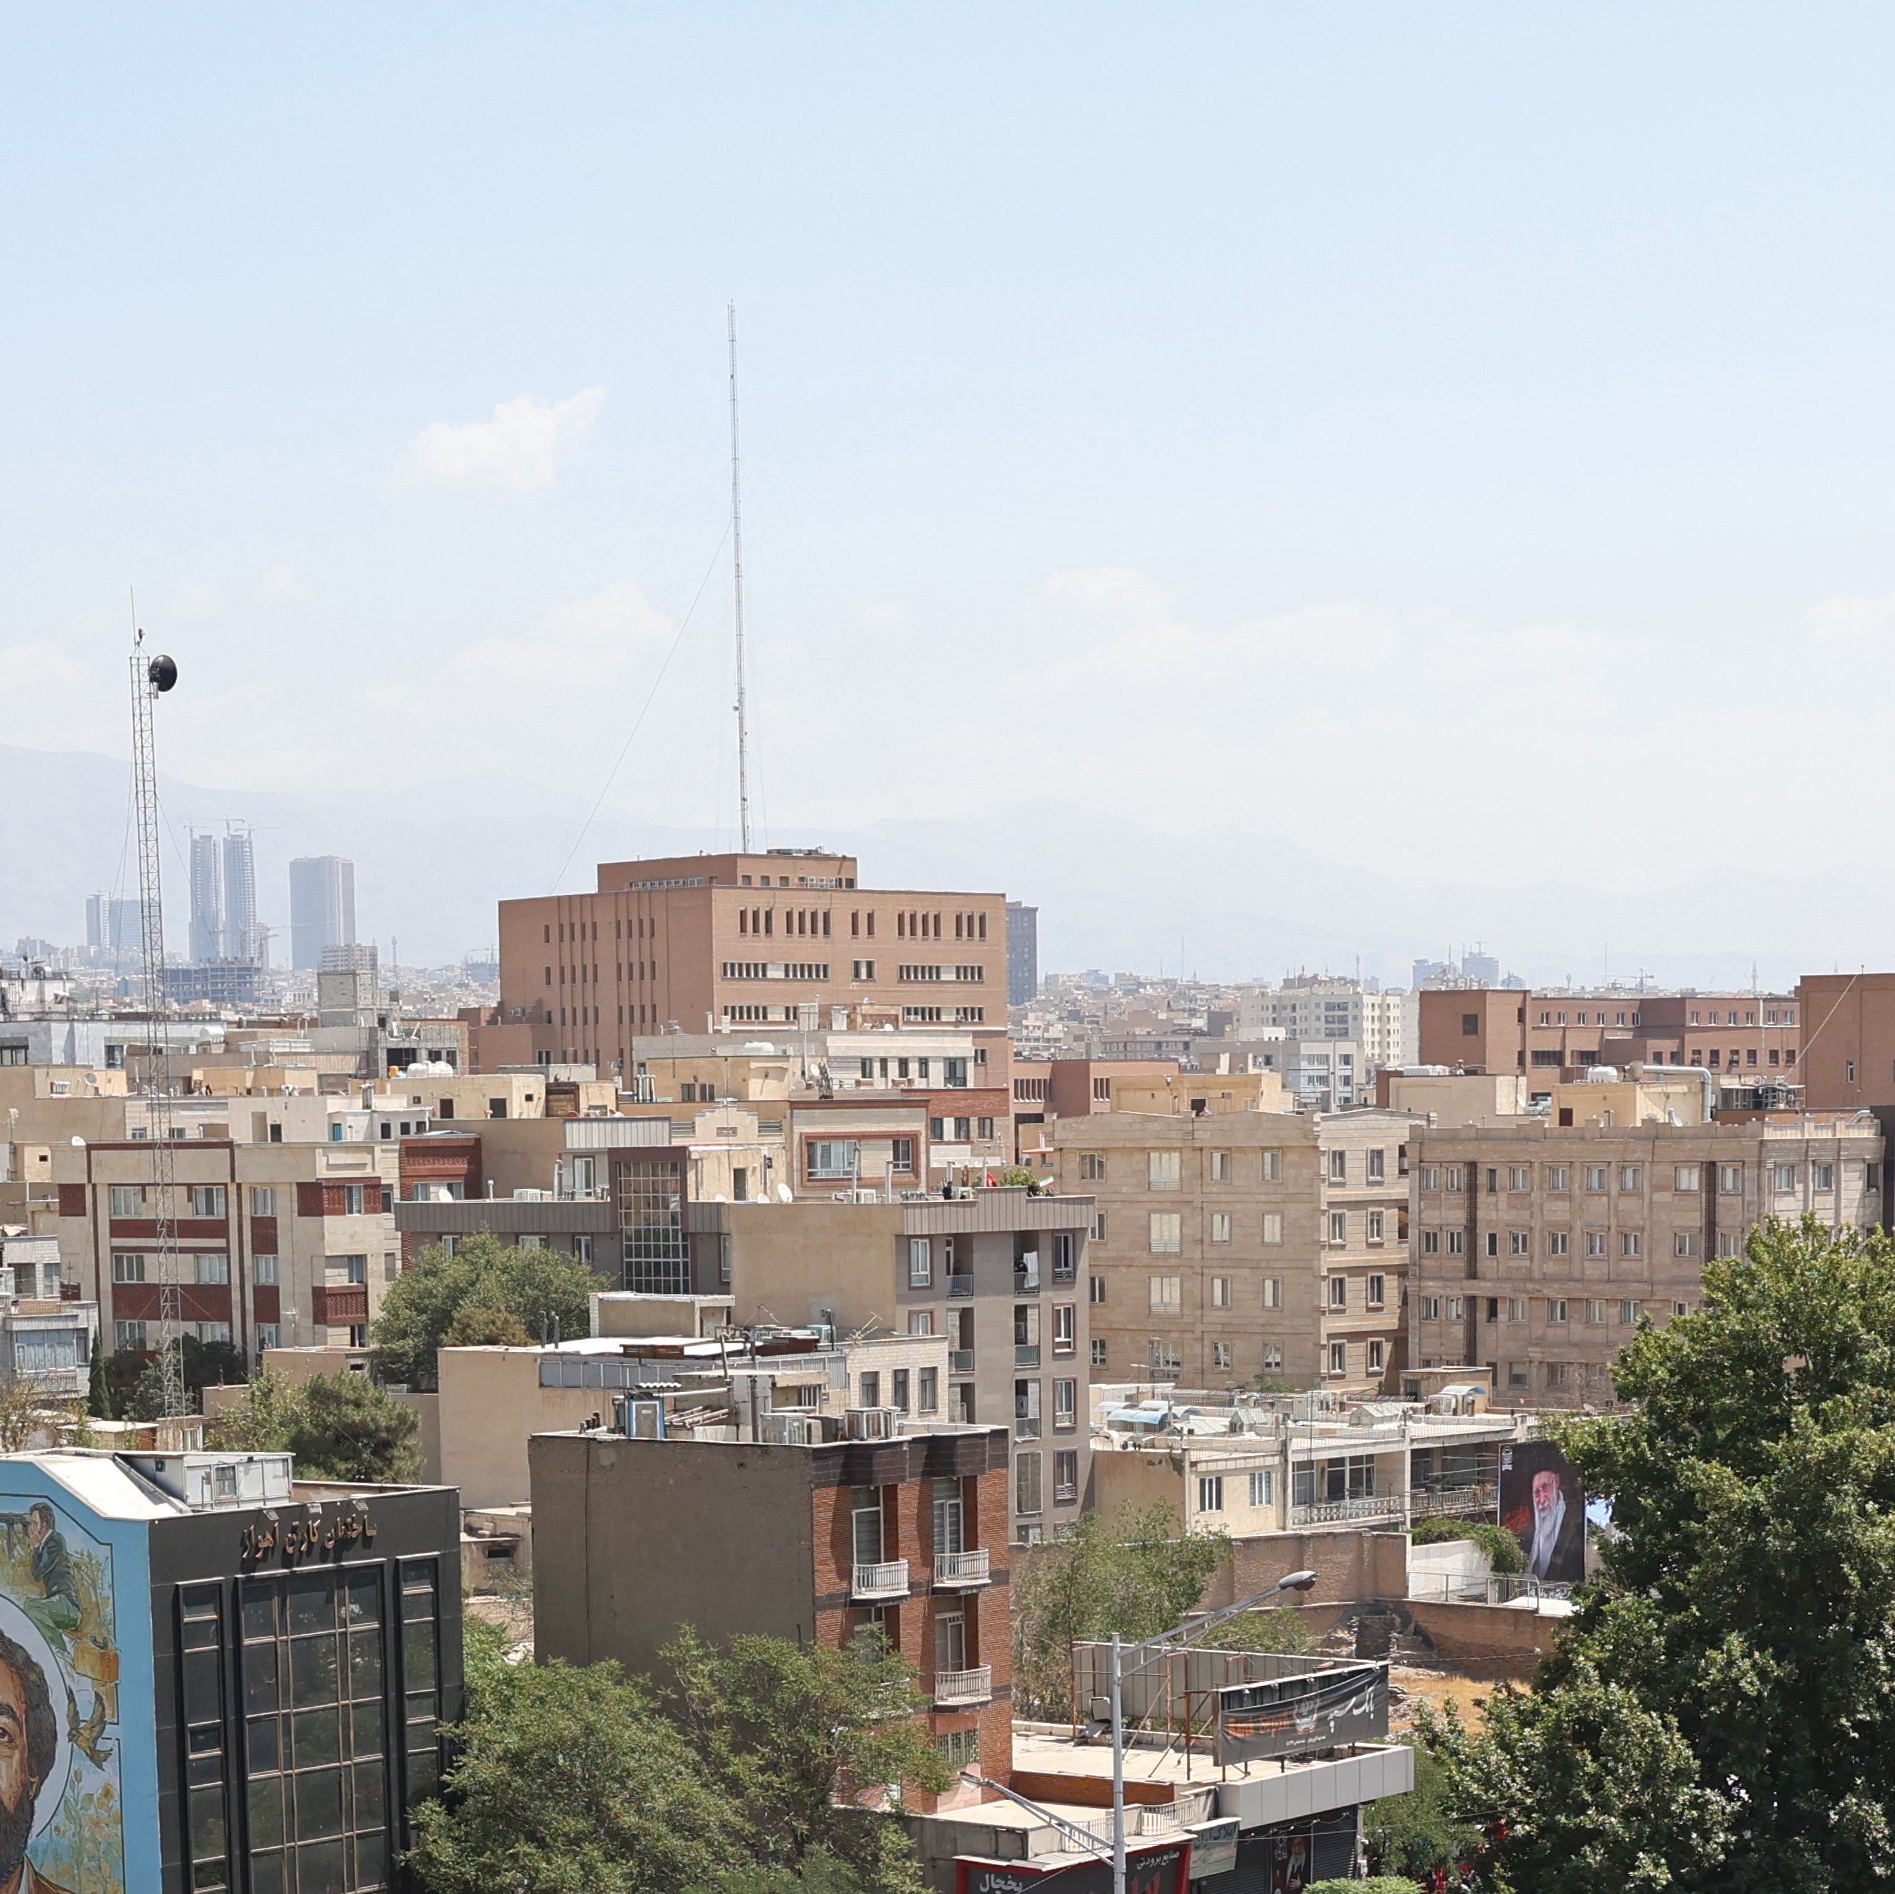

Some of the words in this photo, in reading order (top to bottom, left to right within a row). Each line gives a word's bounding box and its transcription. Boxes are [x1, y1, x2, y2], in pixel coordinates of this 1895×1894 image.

[242, 1521, 279, 1559] اهواز
[1326, 1696, 1356, 1734] سپه
[1352, 1679, 1380, 1721] بانک
[1135, 1855, 1161, 1871] برودتی
[1159, 1849, 1181, 1867] صنایع
